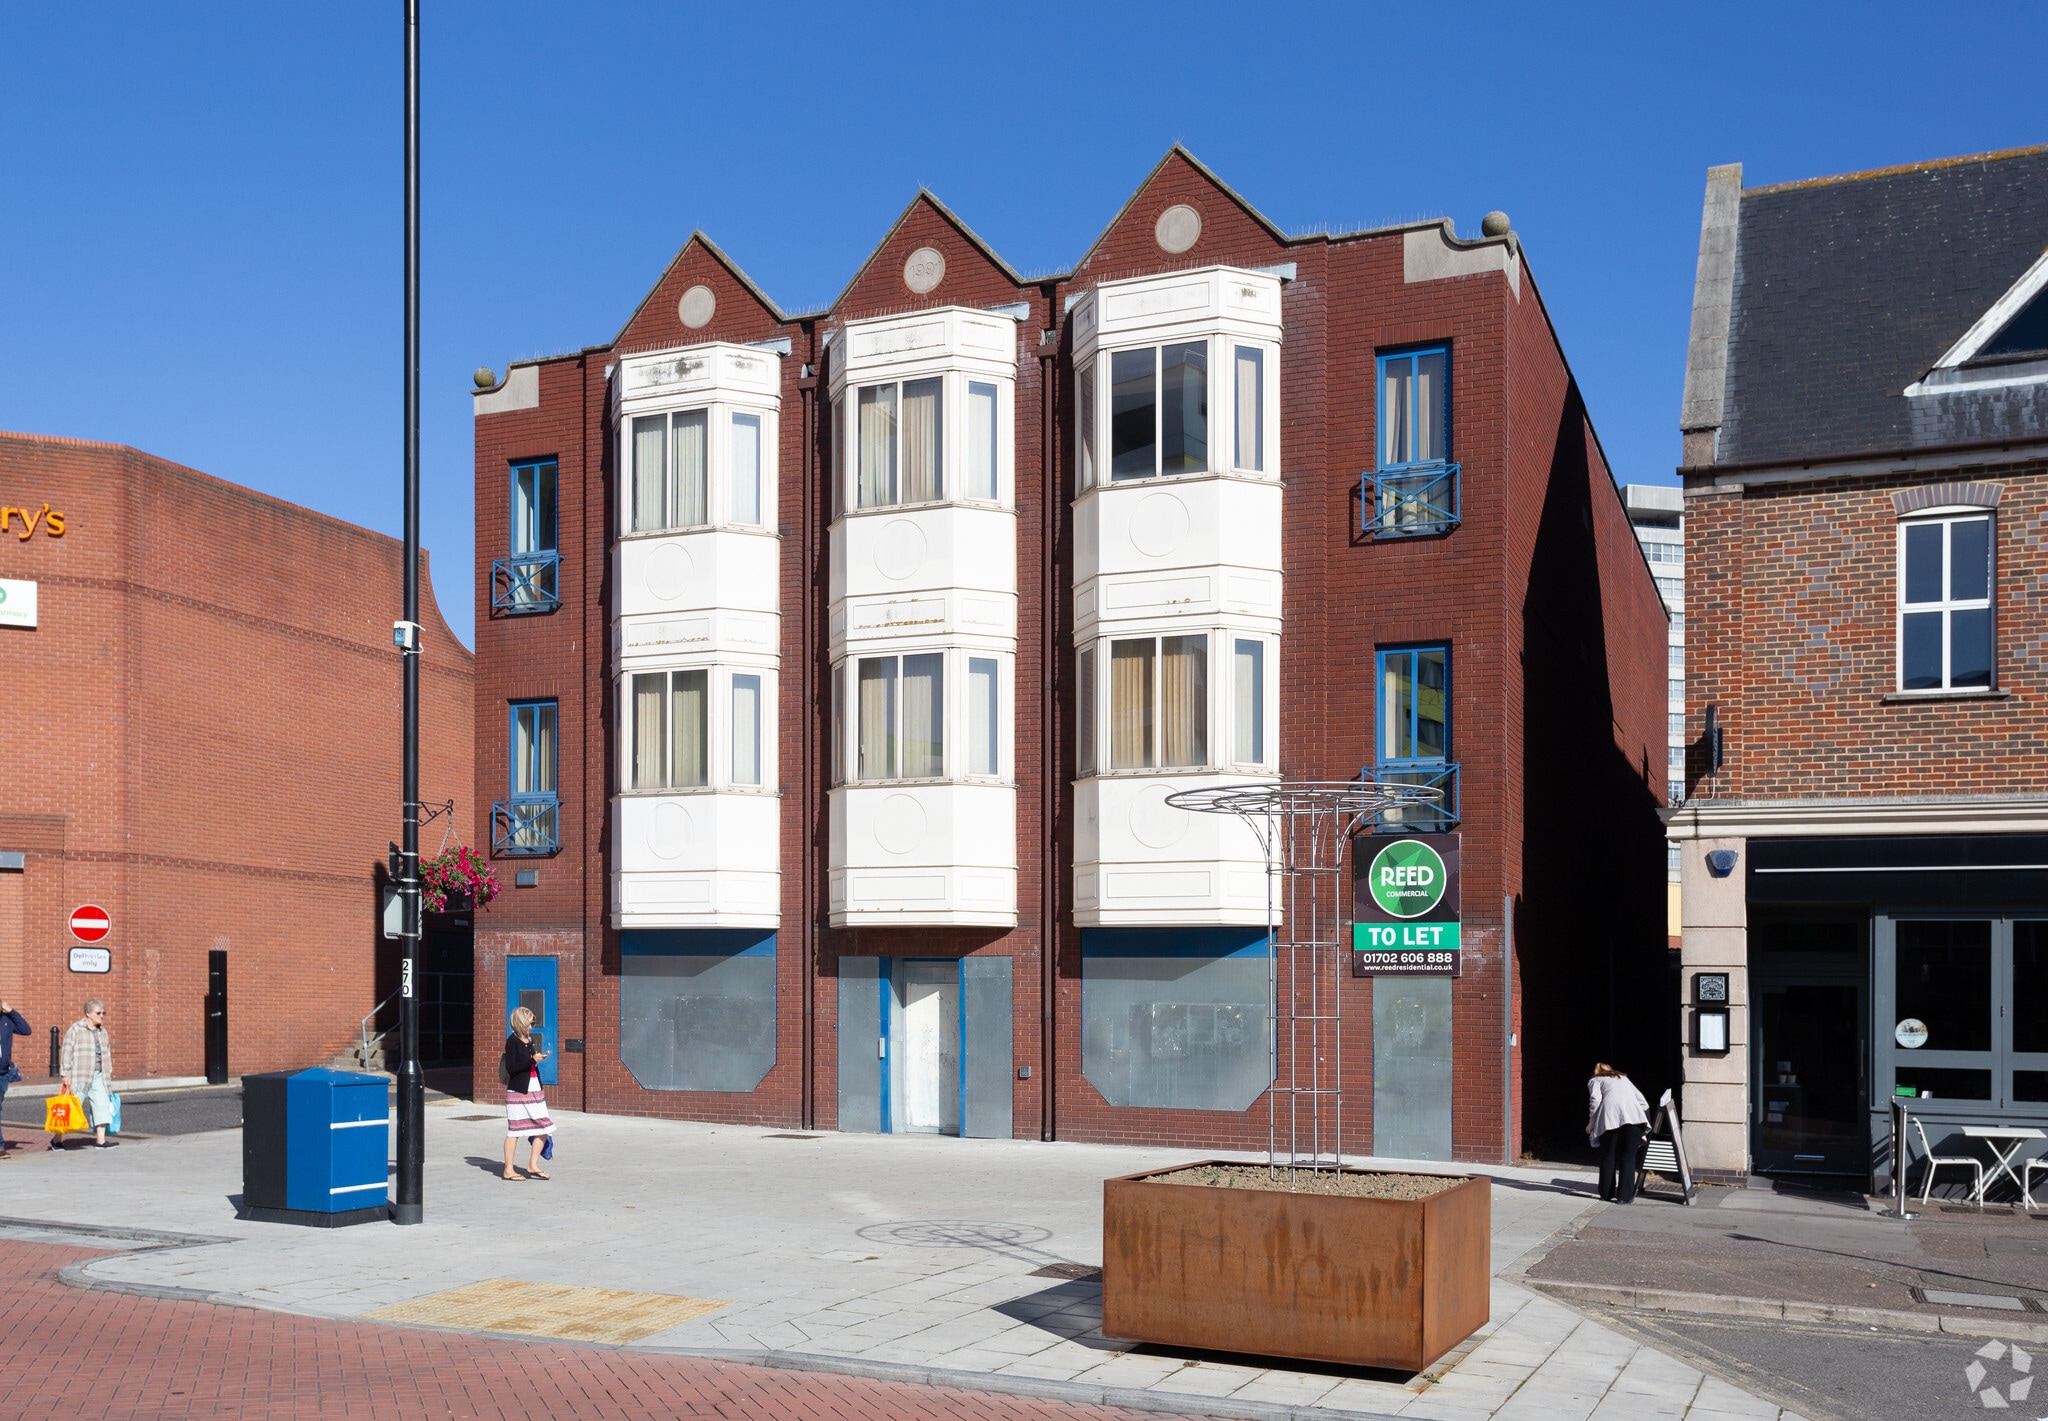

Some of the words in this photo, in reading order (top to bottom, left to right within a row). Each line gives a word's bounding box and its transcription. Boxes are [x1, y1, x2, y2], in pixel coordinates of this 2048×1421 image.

[908, 261, 941, 279] 1991
[1, 502, 66, 540] ry's
[1381, 866, 1434, 886] REED
[1386, 890, 1428, 898] COMMERCIAL
[1368, 927, 1397, 946] TO
[1403, 926, 1443, 945] LET
[73, 952, 107, 960] Deliveries
[1363, 953, 1398, 963] 01702
[1401, 953, 1424, 963] 606
[1427, 953, 1452, 963] 888
[402, 960, 410, 995] 270
